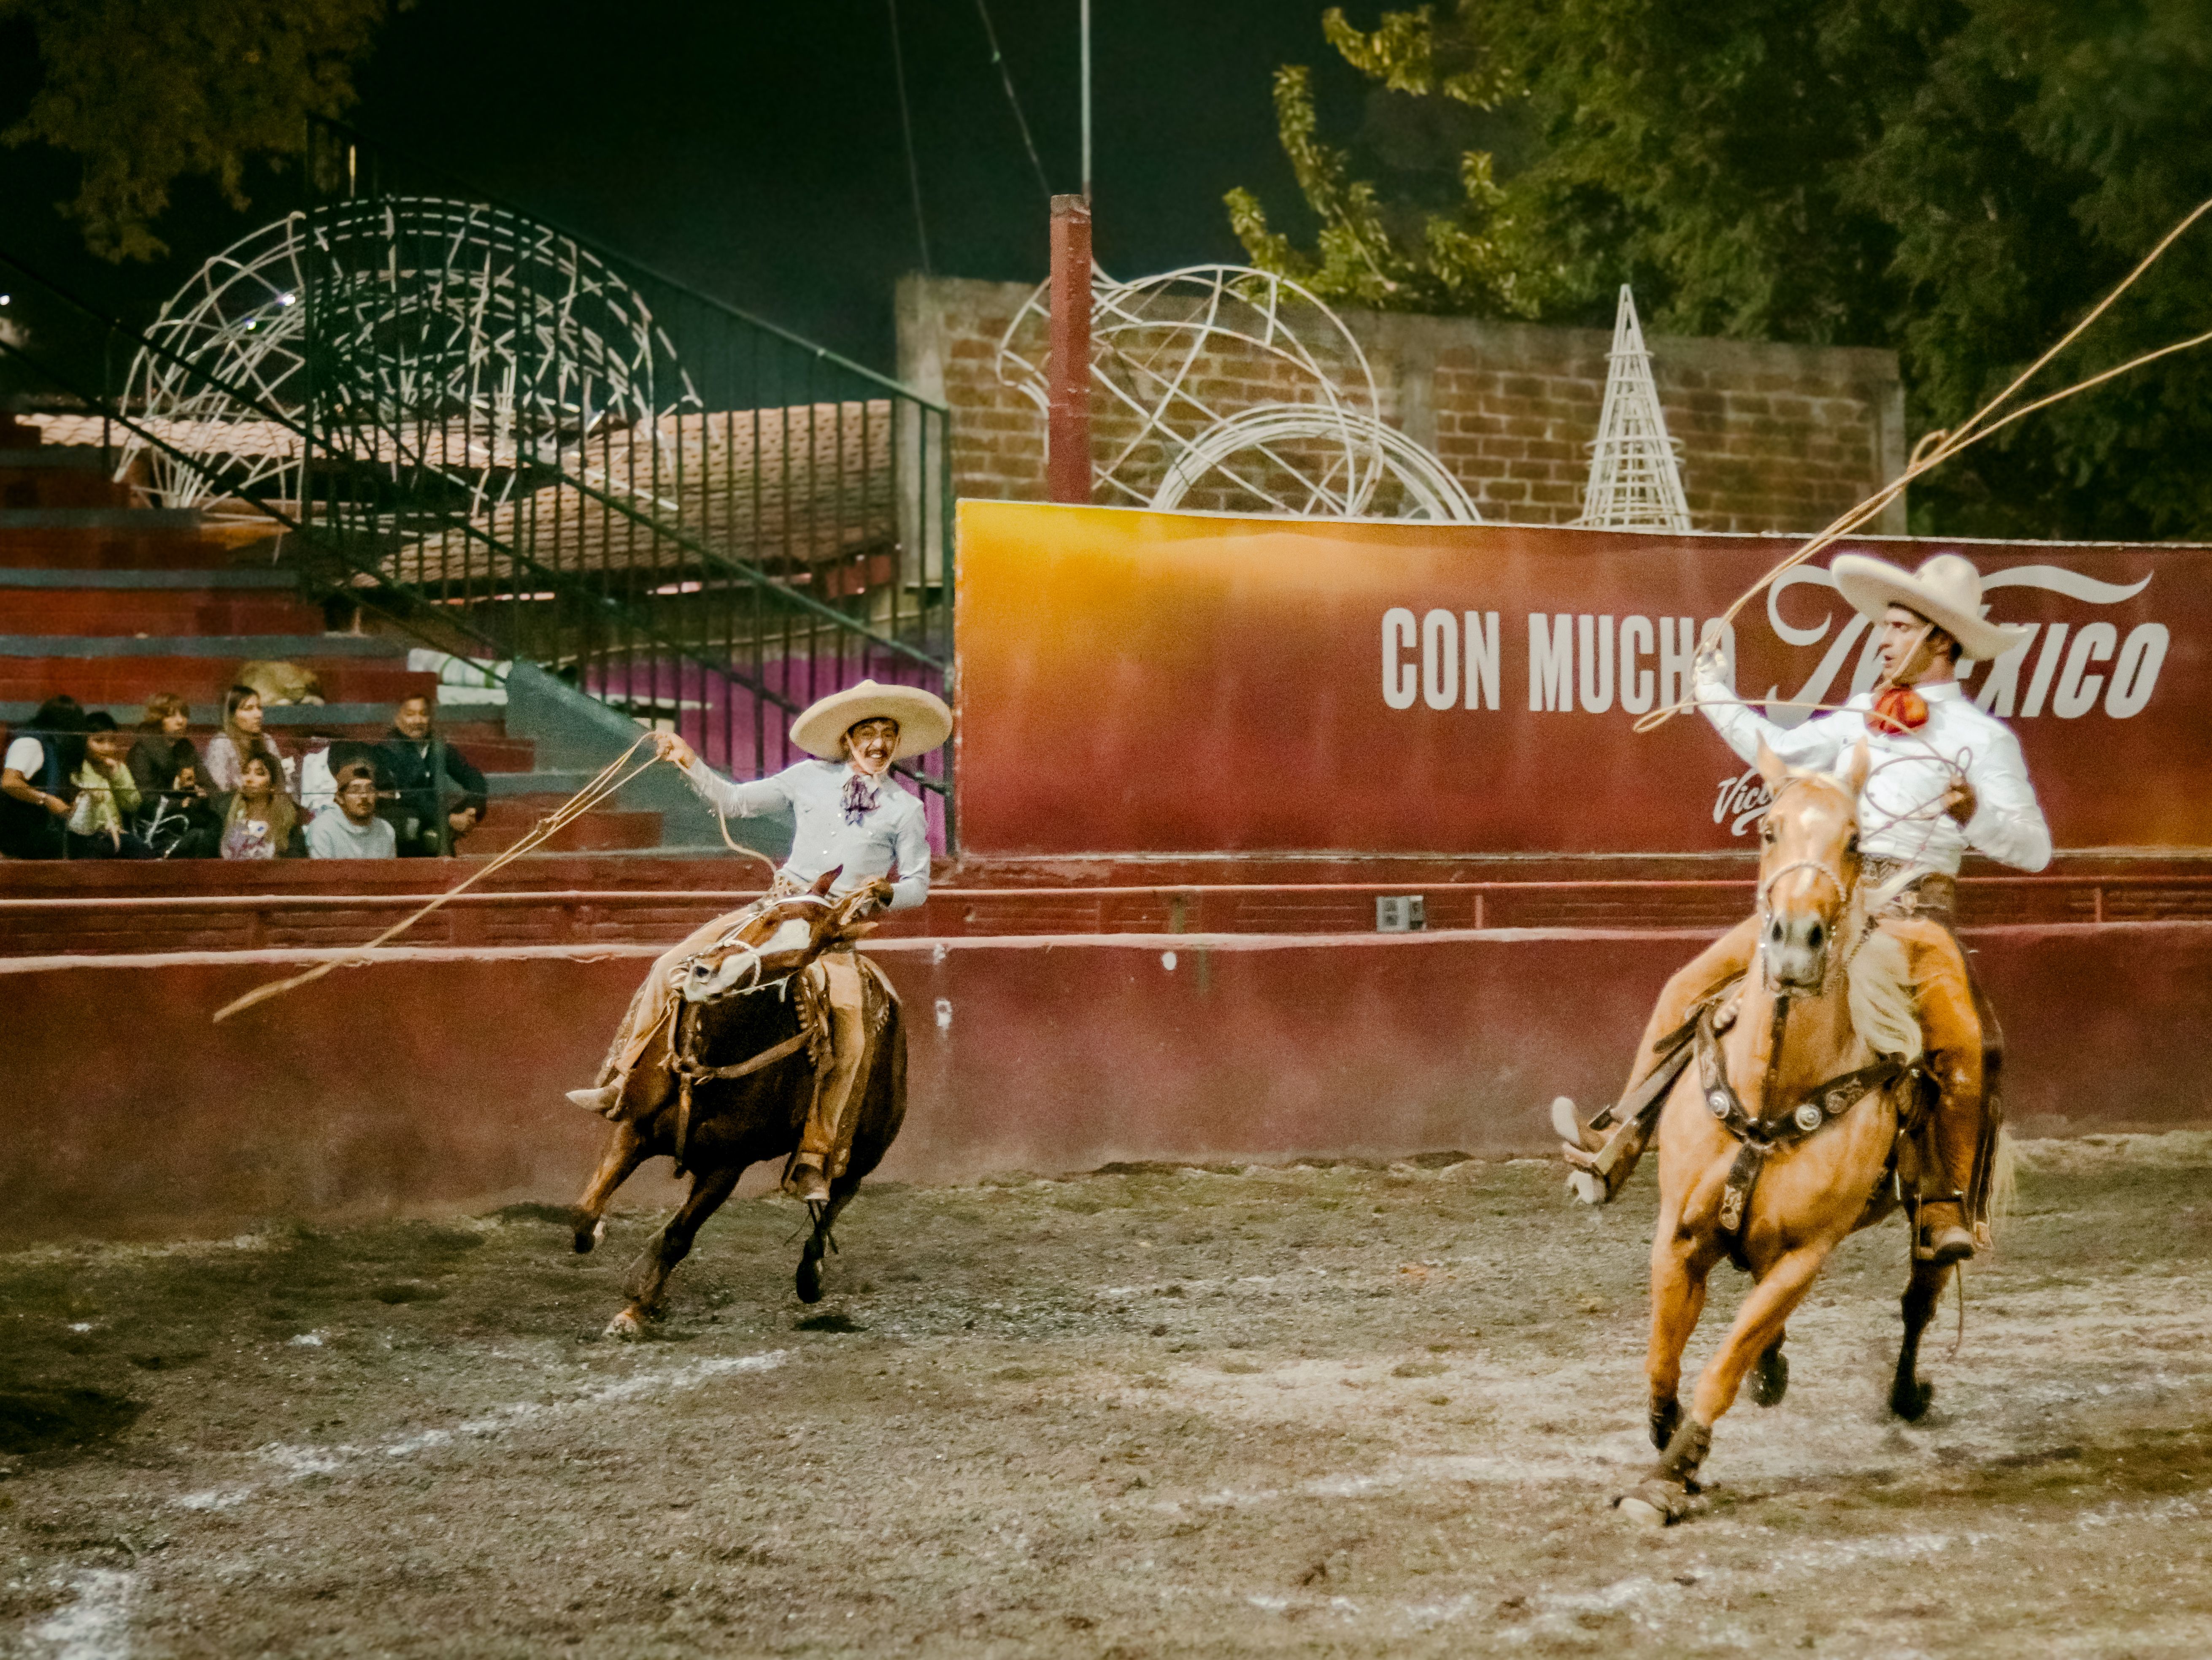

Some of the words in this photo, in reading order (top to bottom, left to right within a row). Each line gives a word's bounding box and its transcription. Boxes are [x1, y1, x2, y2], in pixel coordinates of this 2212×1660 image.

[1382, 607, 1500, 711] CON
[1528, 613, 1736, 714] MUCHO
[1767, 565, 2170, 729] MXICO
